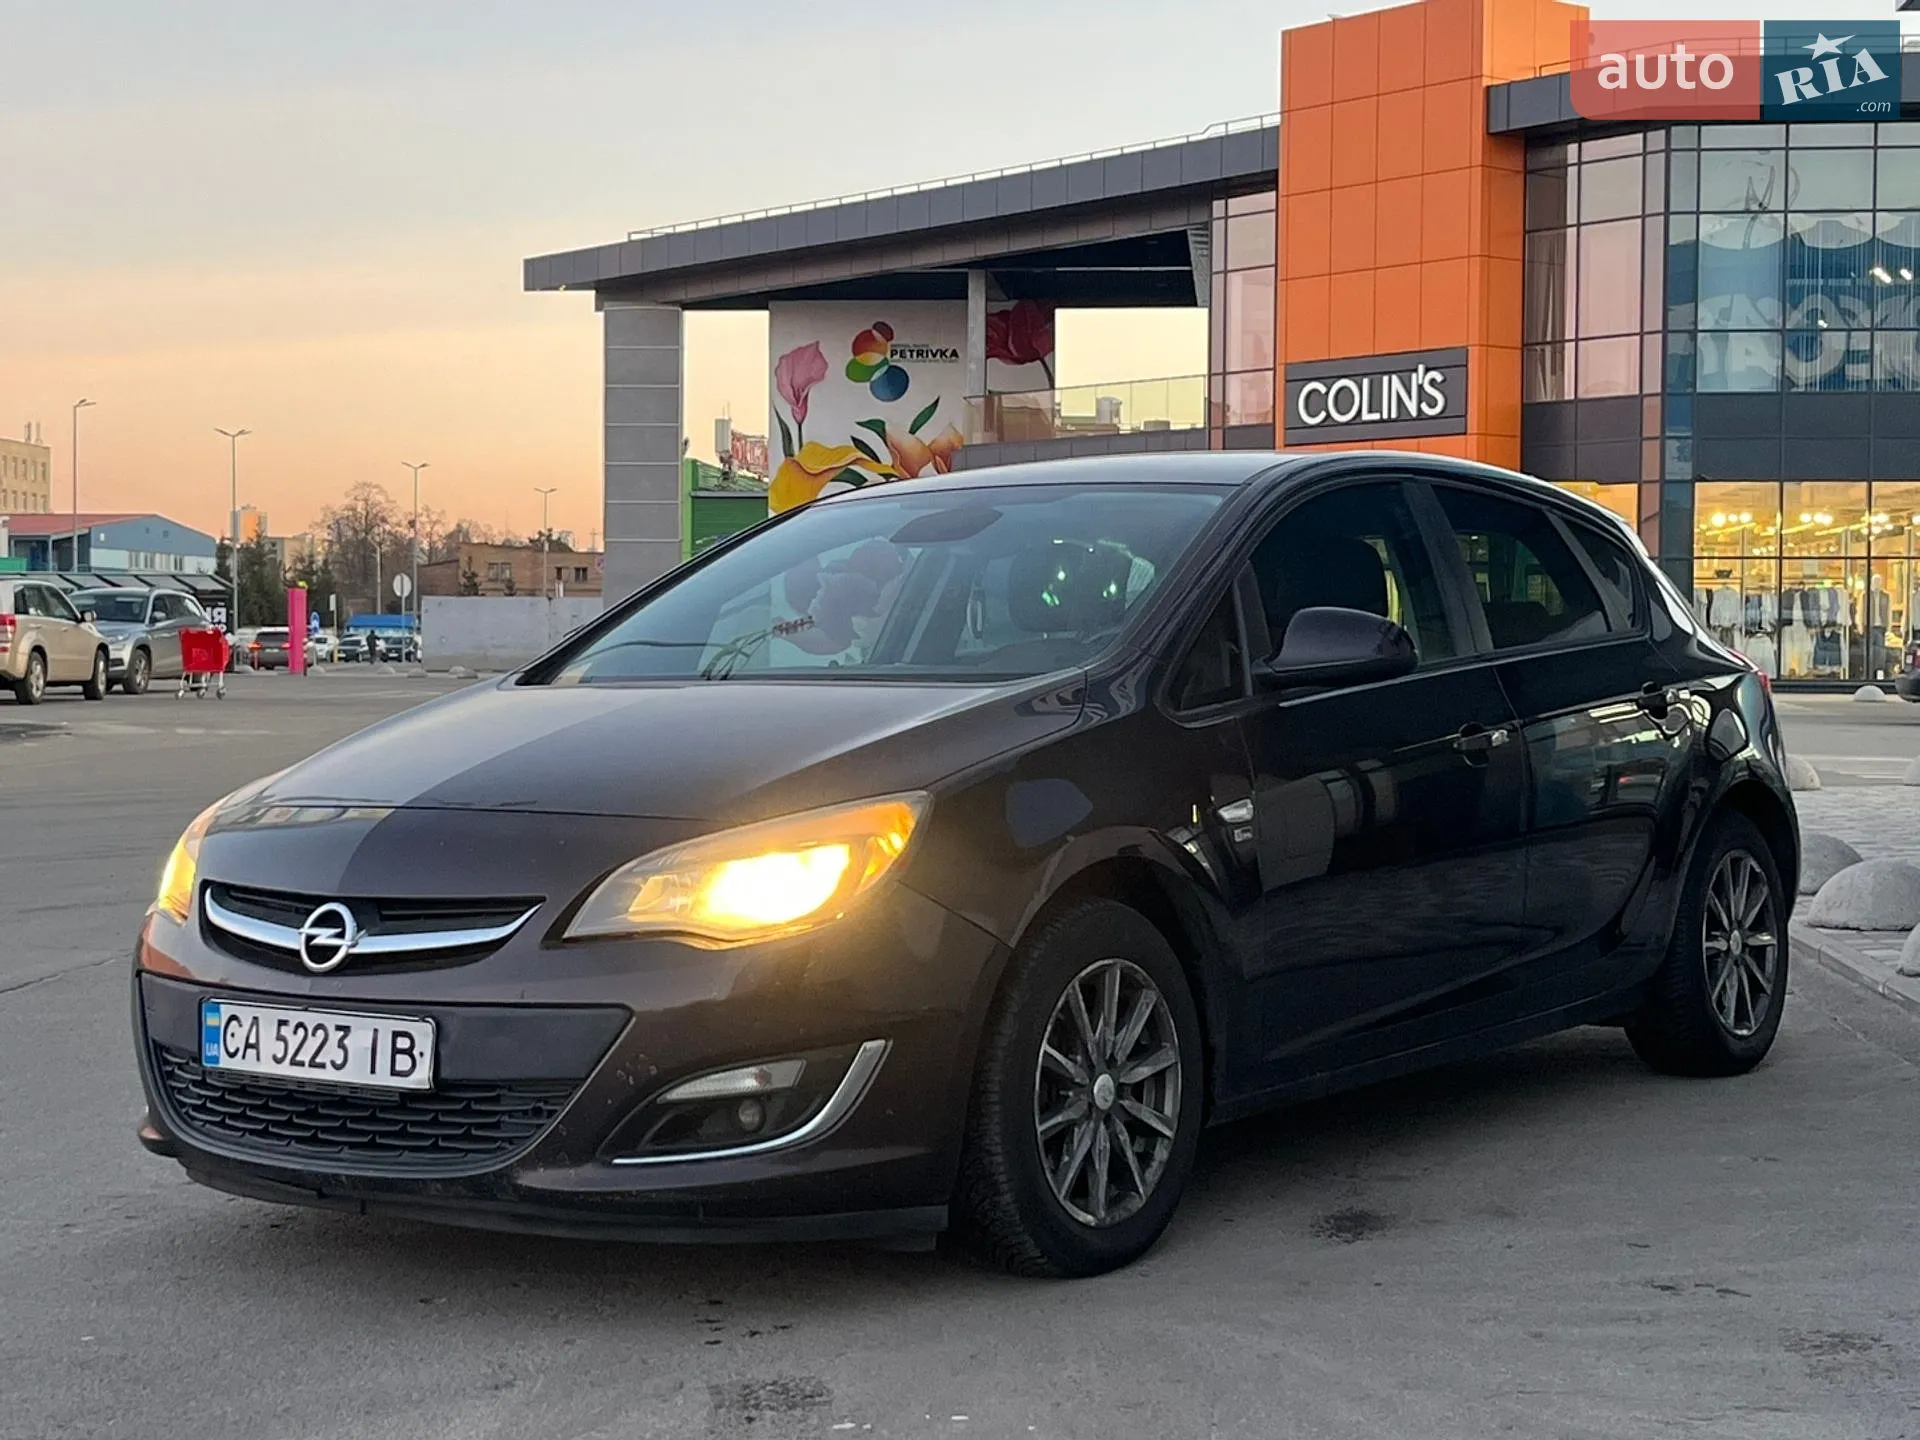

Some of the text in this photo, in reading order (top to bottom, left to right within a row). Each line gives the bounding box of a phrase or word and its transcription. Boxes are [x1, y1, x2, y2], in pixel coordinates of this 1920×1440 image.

[890, 348, 959, 359] PETRIVKA
[1298, 363, 1446, 425] COLIN'S
[205, 1042, 219, 1057] UA
[222, 1014, 418, 1077] CA 5223 IB
